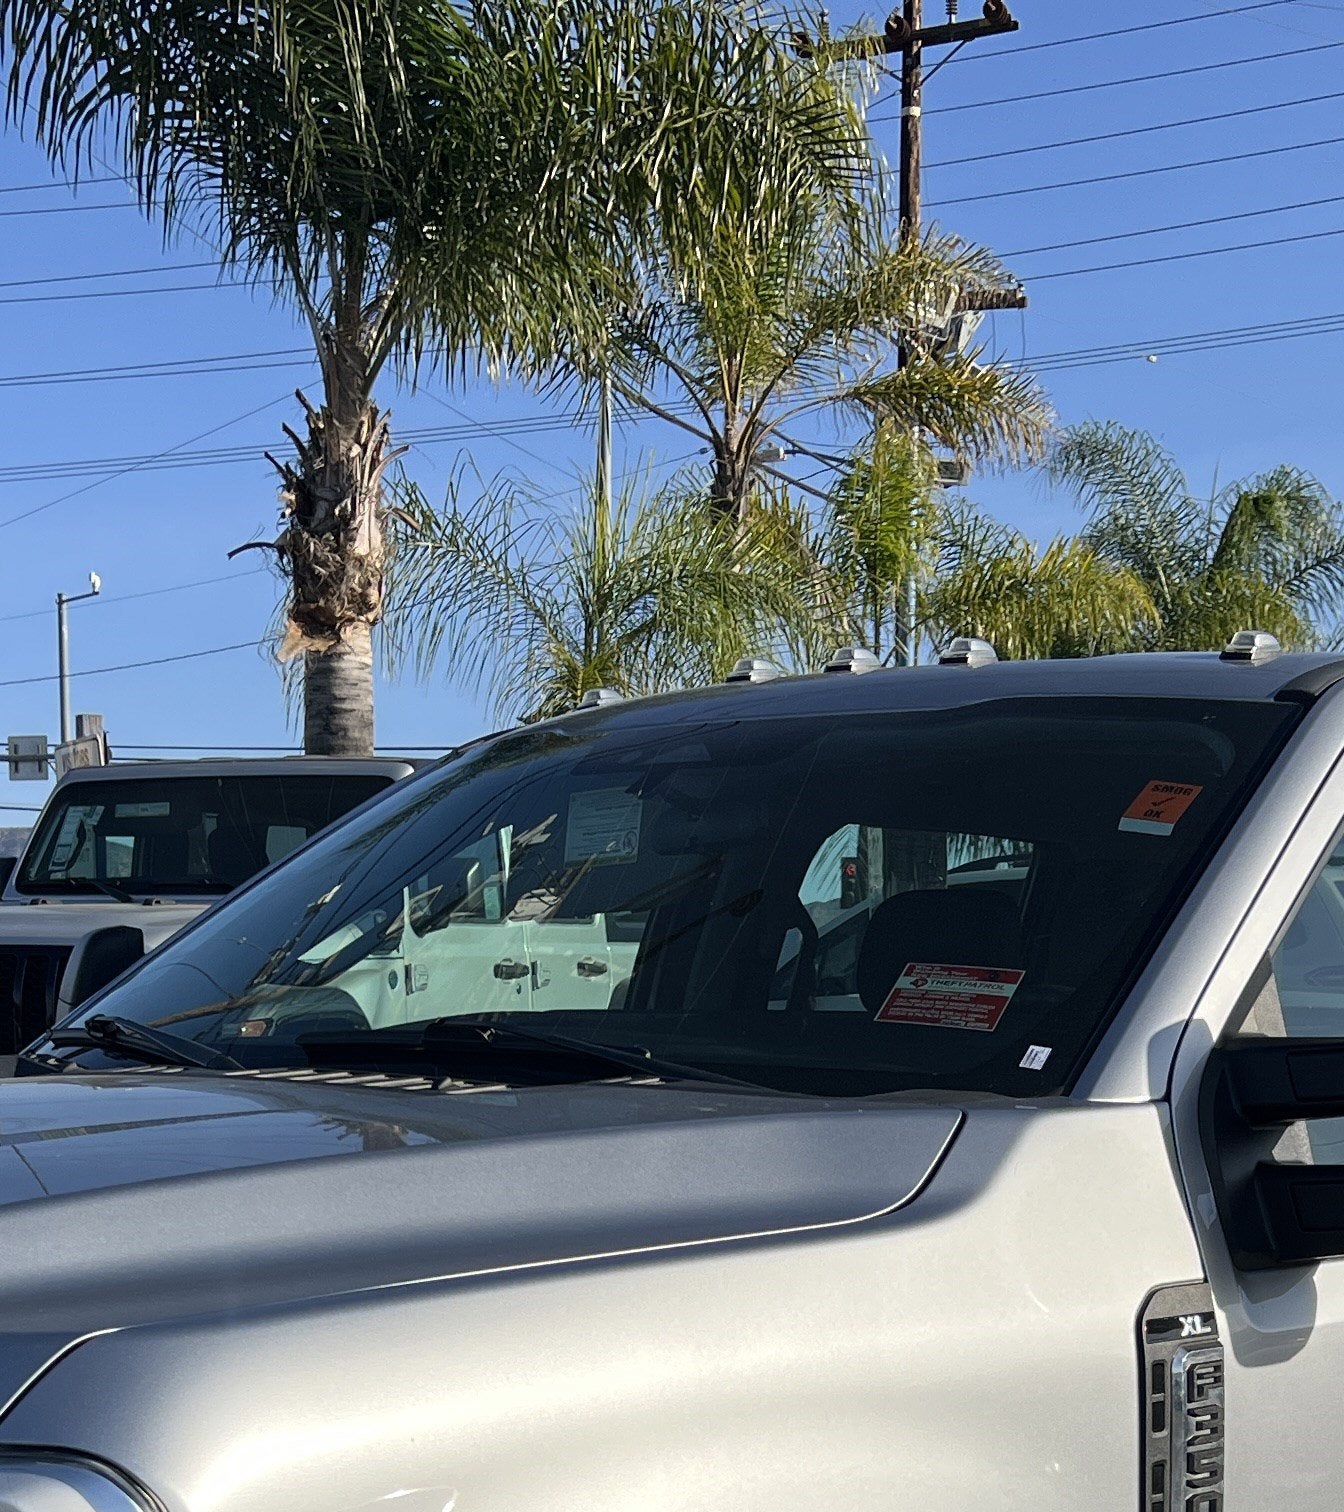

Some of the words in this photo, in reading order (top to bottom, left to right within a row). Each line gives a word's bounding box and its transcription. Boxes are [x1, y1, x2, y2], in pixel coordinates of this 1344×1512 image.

[1151, 784, 1194, 796] SMOG
[1143, 808, 1166, 818] OK
[1178, 1314, 1212, 1337] XL
